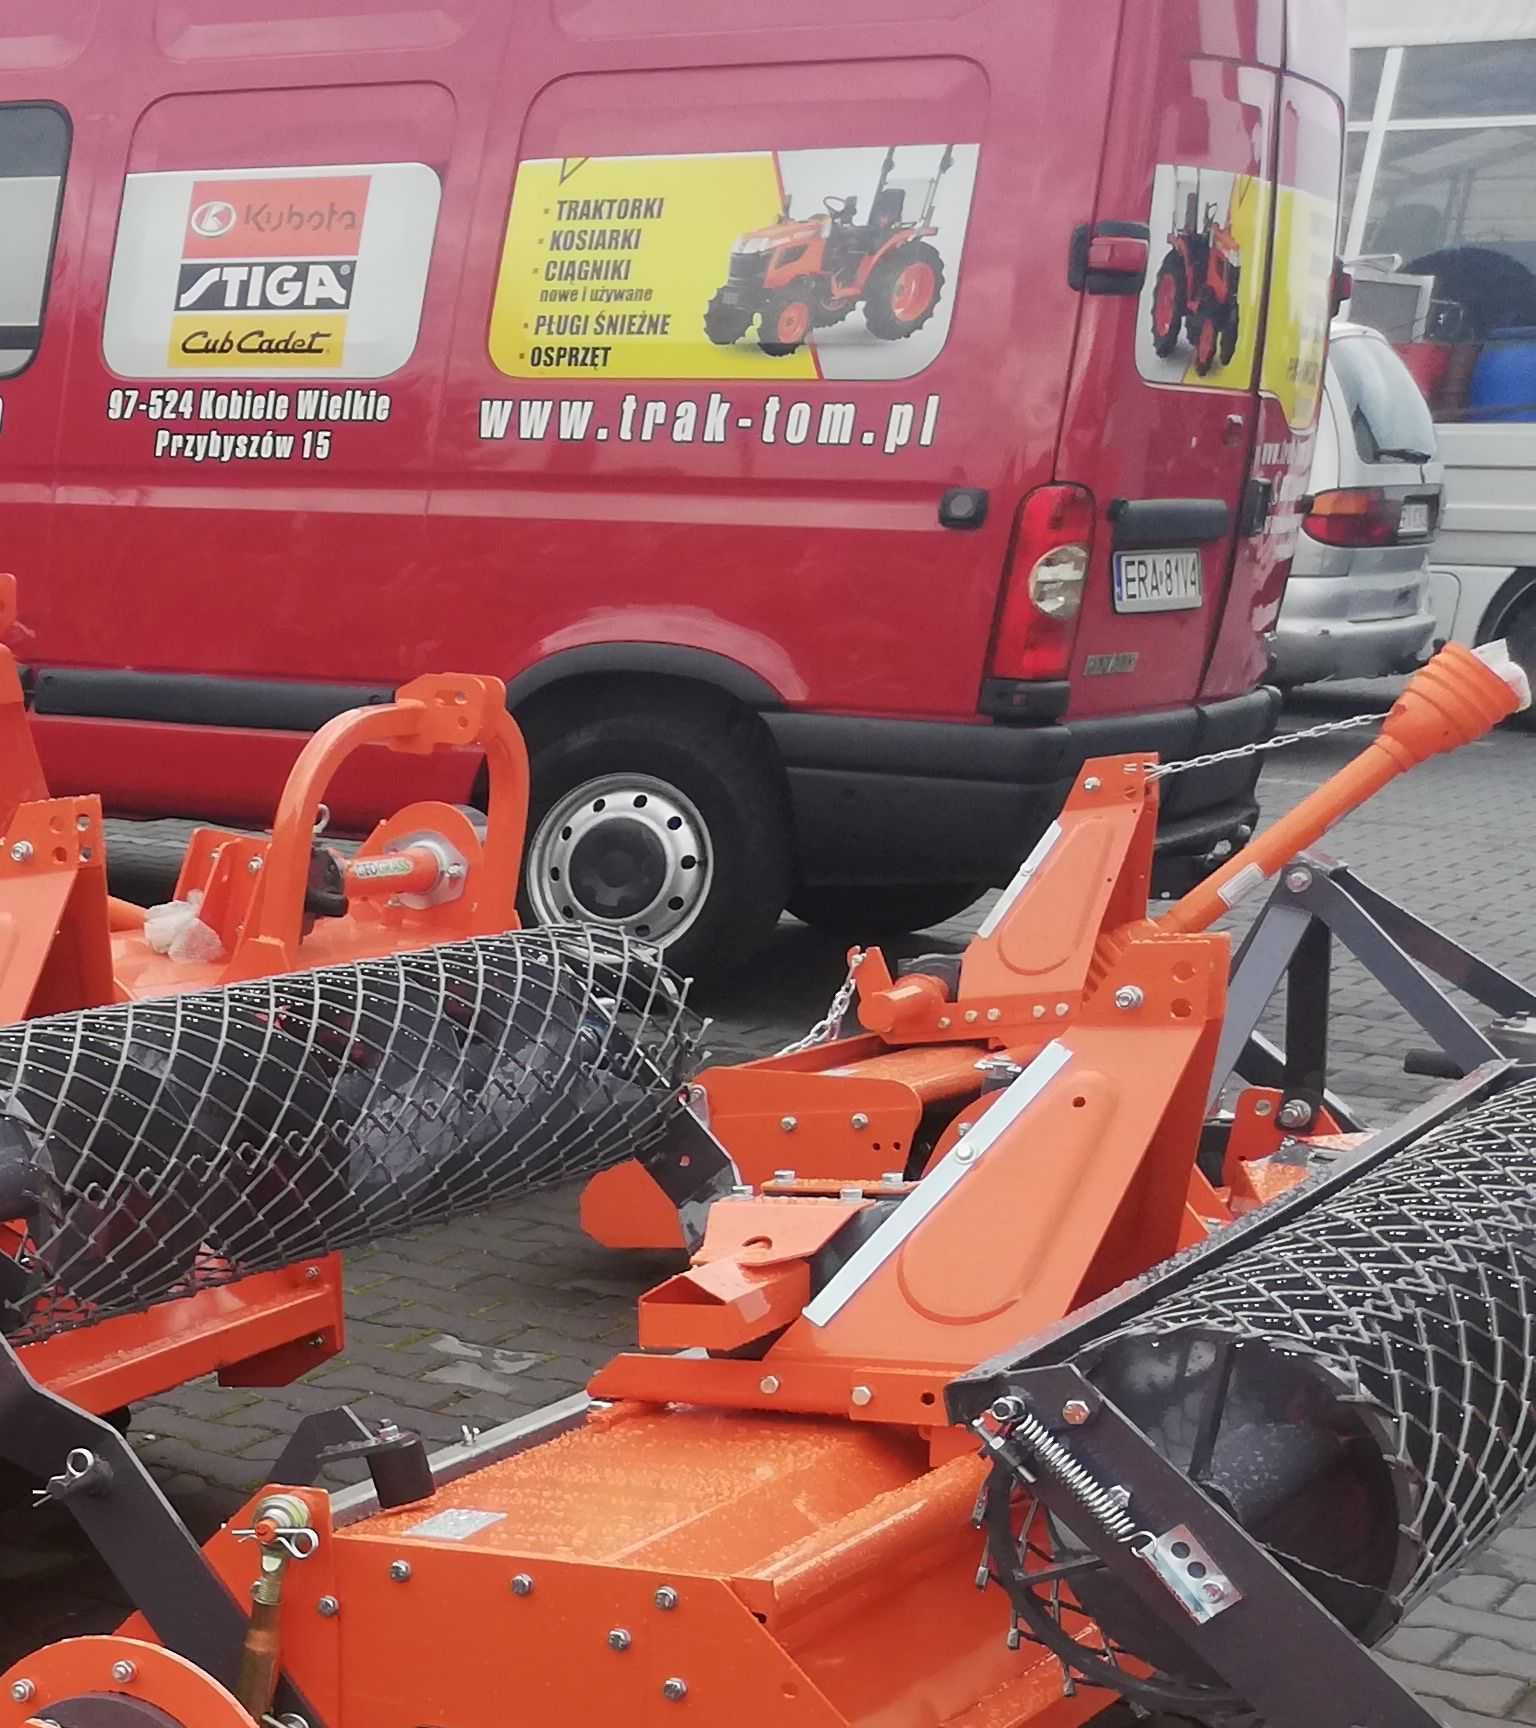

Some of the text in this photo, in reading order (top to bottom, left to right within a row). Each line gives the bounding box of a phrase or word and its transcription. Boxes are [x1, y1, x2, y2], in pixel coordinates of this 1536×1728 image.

[245, 202, 357, 232] Kubota
[556, 197, 665, 221] TRAKTORKI
[549, 228, 642, 251] KOSIARKI
[544, 259, 632, 284] CIĄGNIKI
[178, 264, 348, 308] STIGA
[539, 285, 653, 304] nowe i używane
[534, 310, 672, 336] PŁUGI ŚNIEŻNE
[181, 329, 332, 354] Cub Cadet
[530, 346, 612, 371] OSPRZĘT
[107, 390, 392, 421] 97-524 Kobiele Wielkie
[479, 393, 941, 453] www.trak-tom.pl
[154, 429, 332, 462] Przybyszów 15
[1125, 559, 1160, 599] ERA
